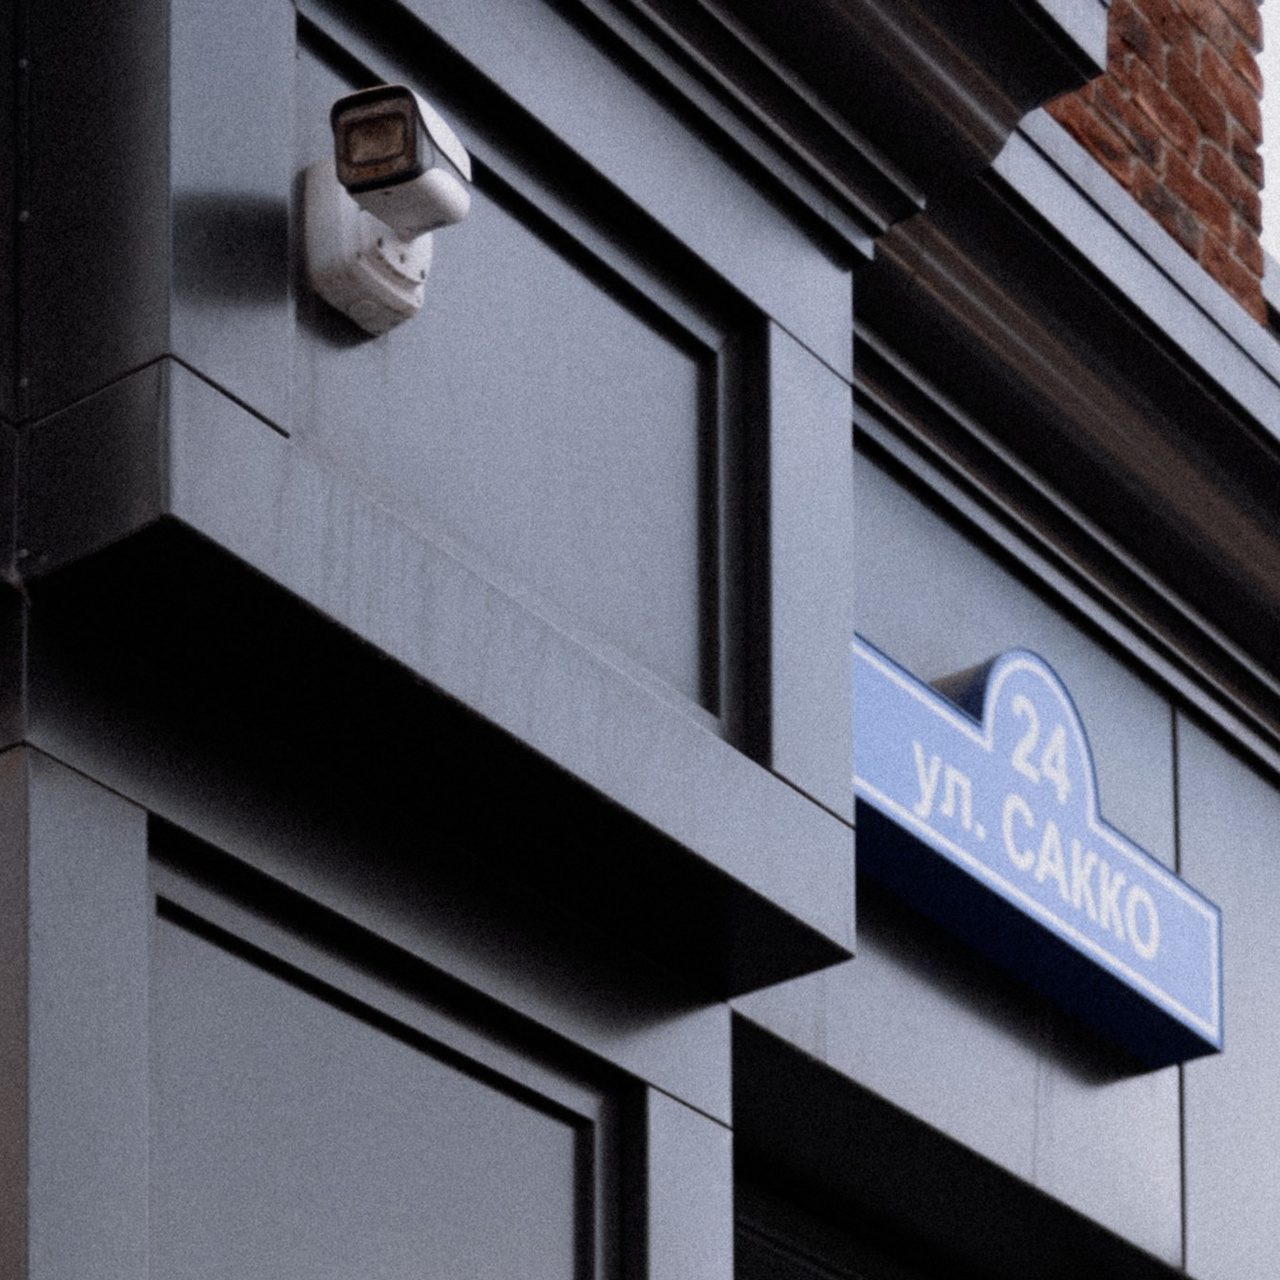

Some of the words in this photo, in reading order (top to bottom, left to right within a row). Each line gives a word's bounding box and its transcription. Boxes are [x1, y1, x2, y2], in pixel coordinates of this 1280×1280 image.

[1011, 695, 1071, 805] 24
[913, 740, 985, 839] ул.
[1002, 795, 1159, 959] САККО
